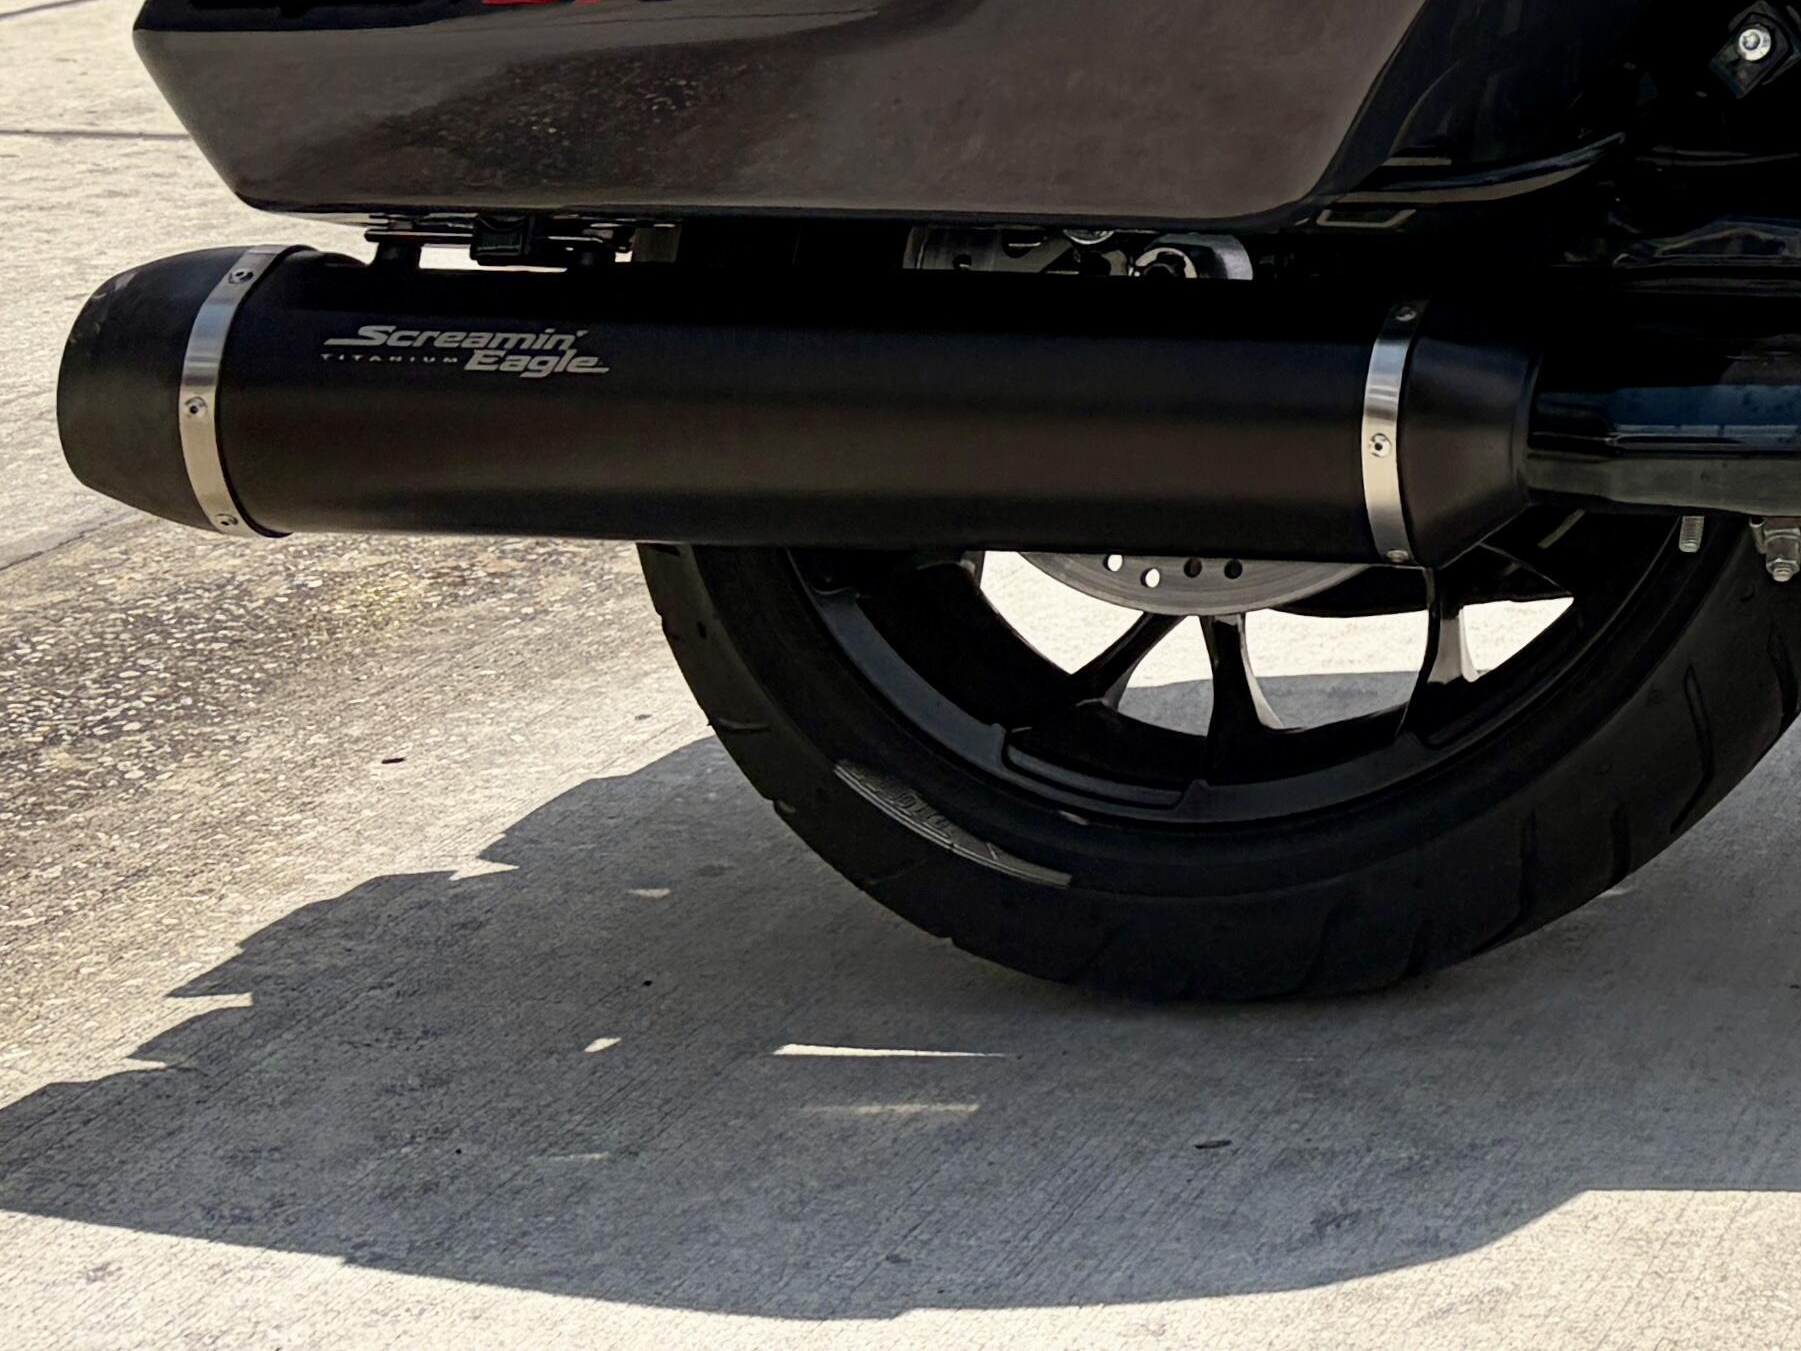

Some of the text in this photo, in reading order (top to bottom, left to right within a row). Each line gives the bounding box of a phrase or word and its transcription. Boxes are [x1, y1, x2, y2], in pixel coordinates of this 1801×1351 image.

[323, 324, 589, 350] Screamin'
[320, 348, 611, 379] TITANIUM Eagle
